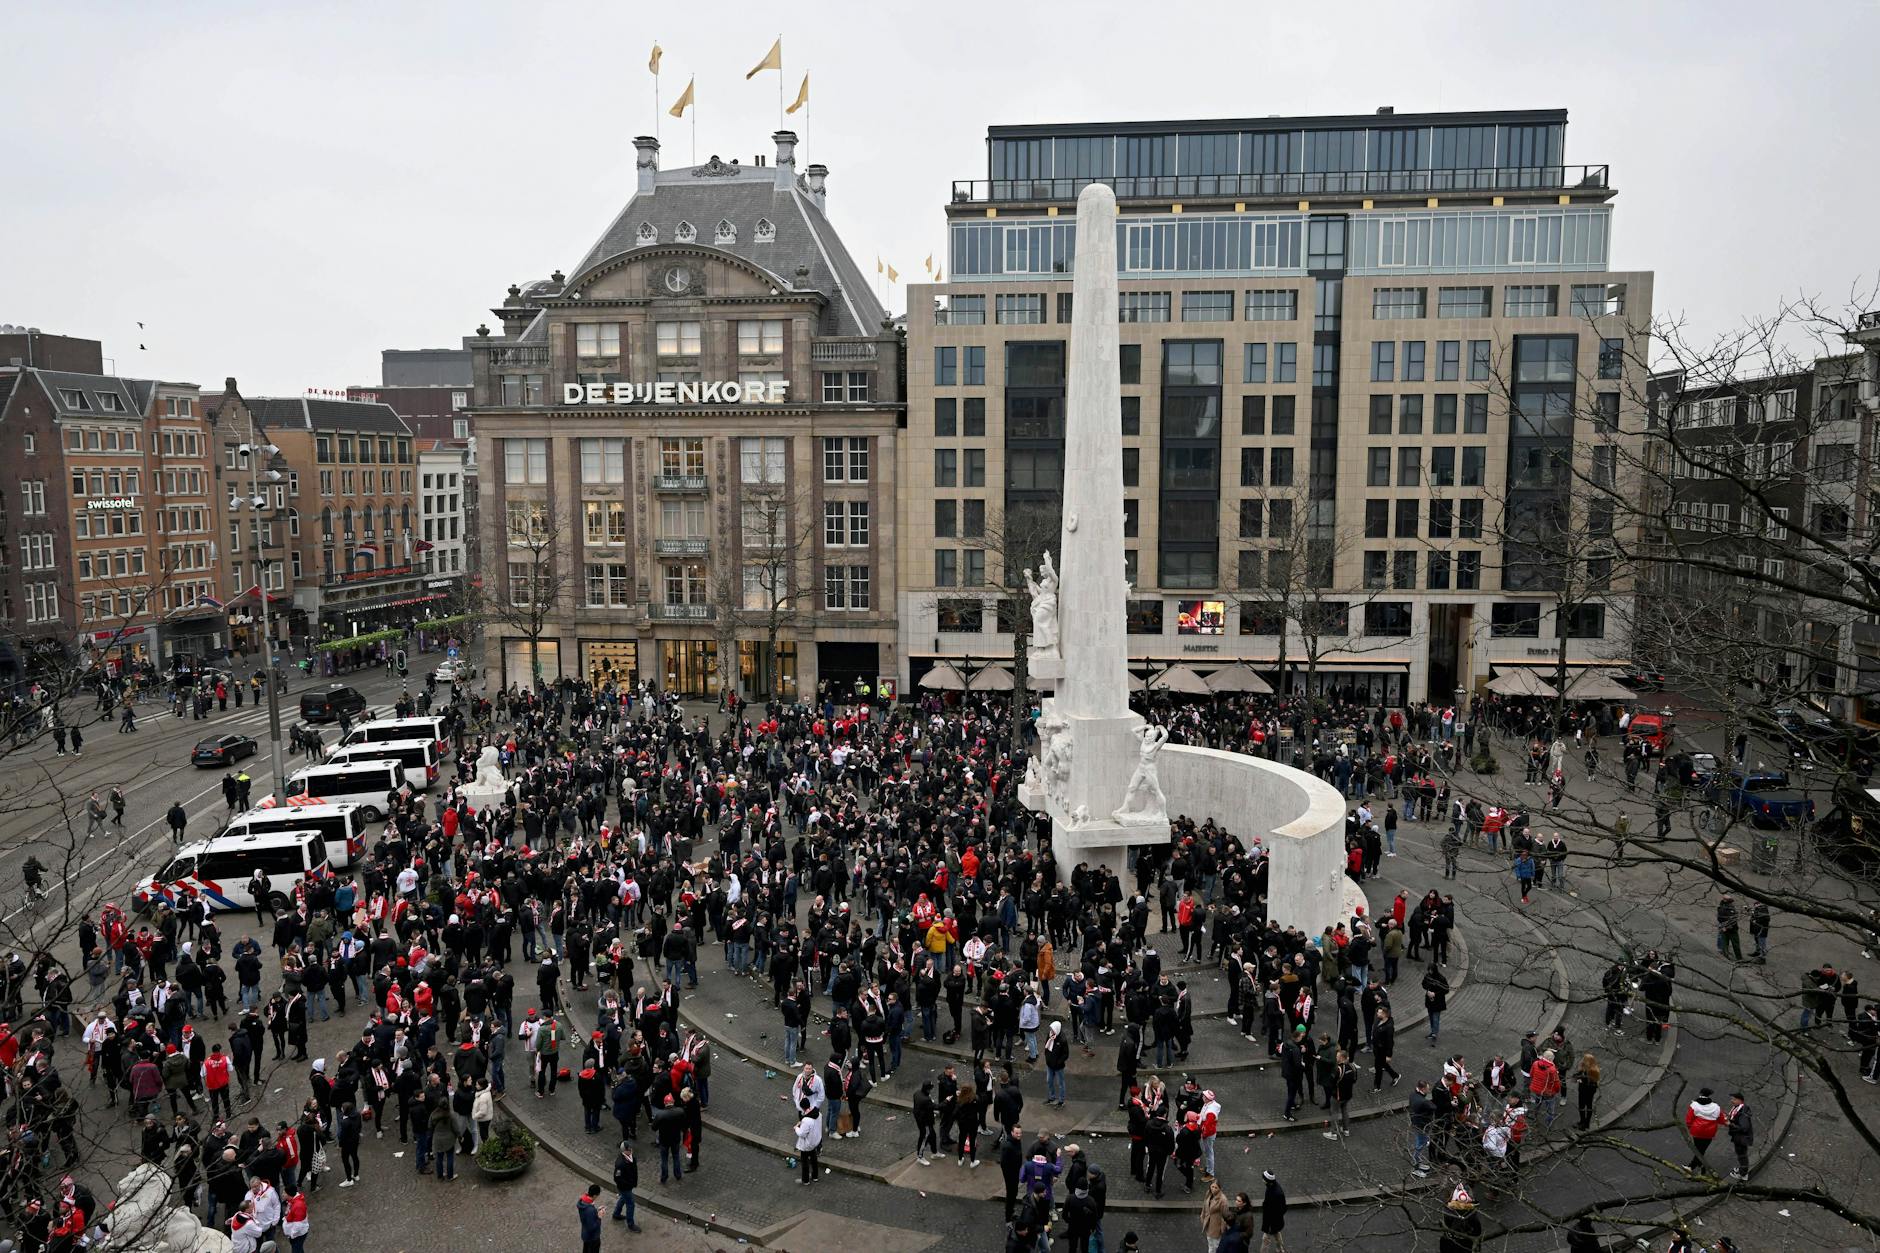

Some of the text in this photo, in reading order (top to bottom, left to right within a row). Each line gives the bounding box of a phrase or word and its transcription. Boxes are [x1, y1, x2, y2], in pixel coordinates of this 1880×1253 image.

[563, 380, 790, 405] DE BIJENKORF
[1183, 644, 1219, 652] MAJESTIC
